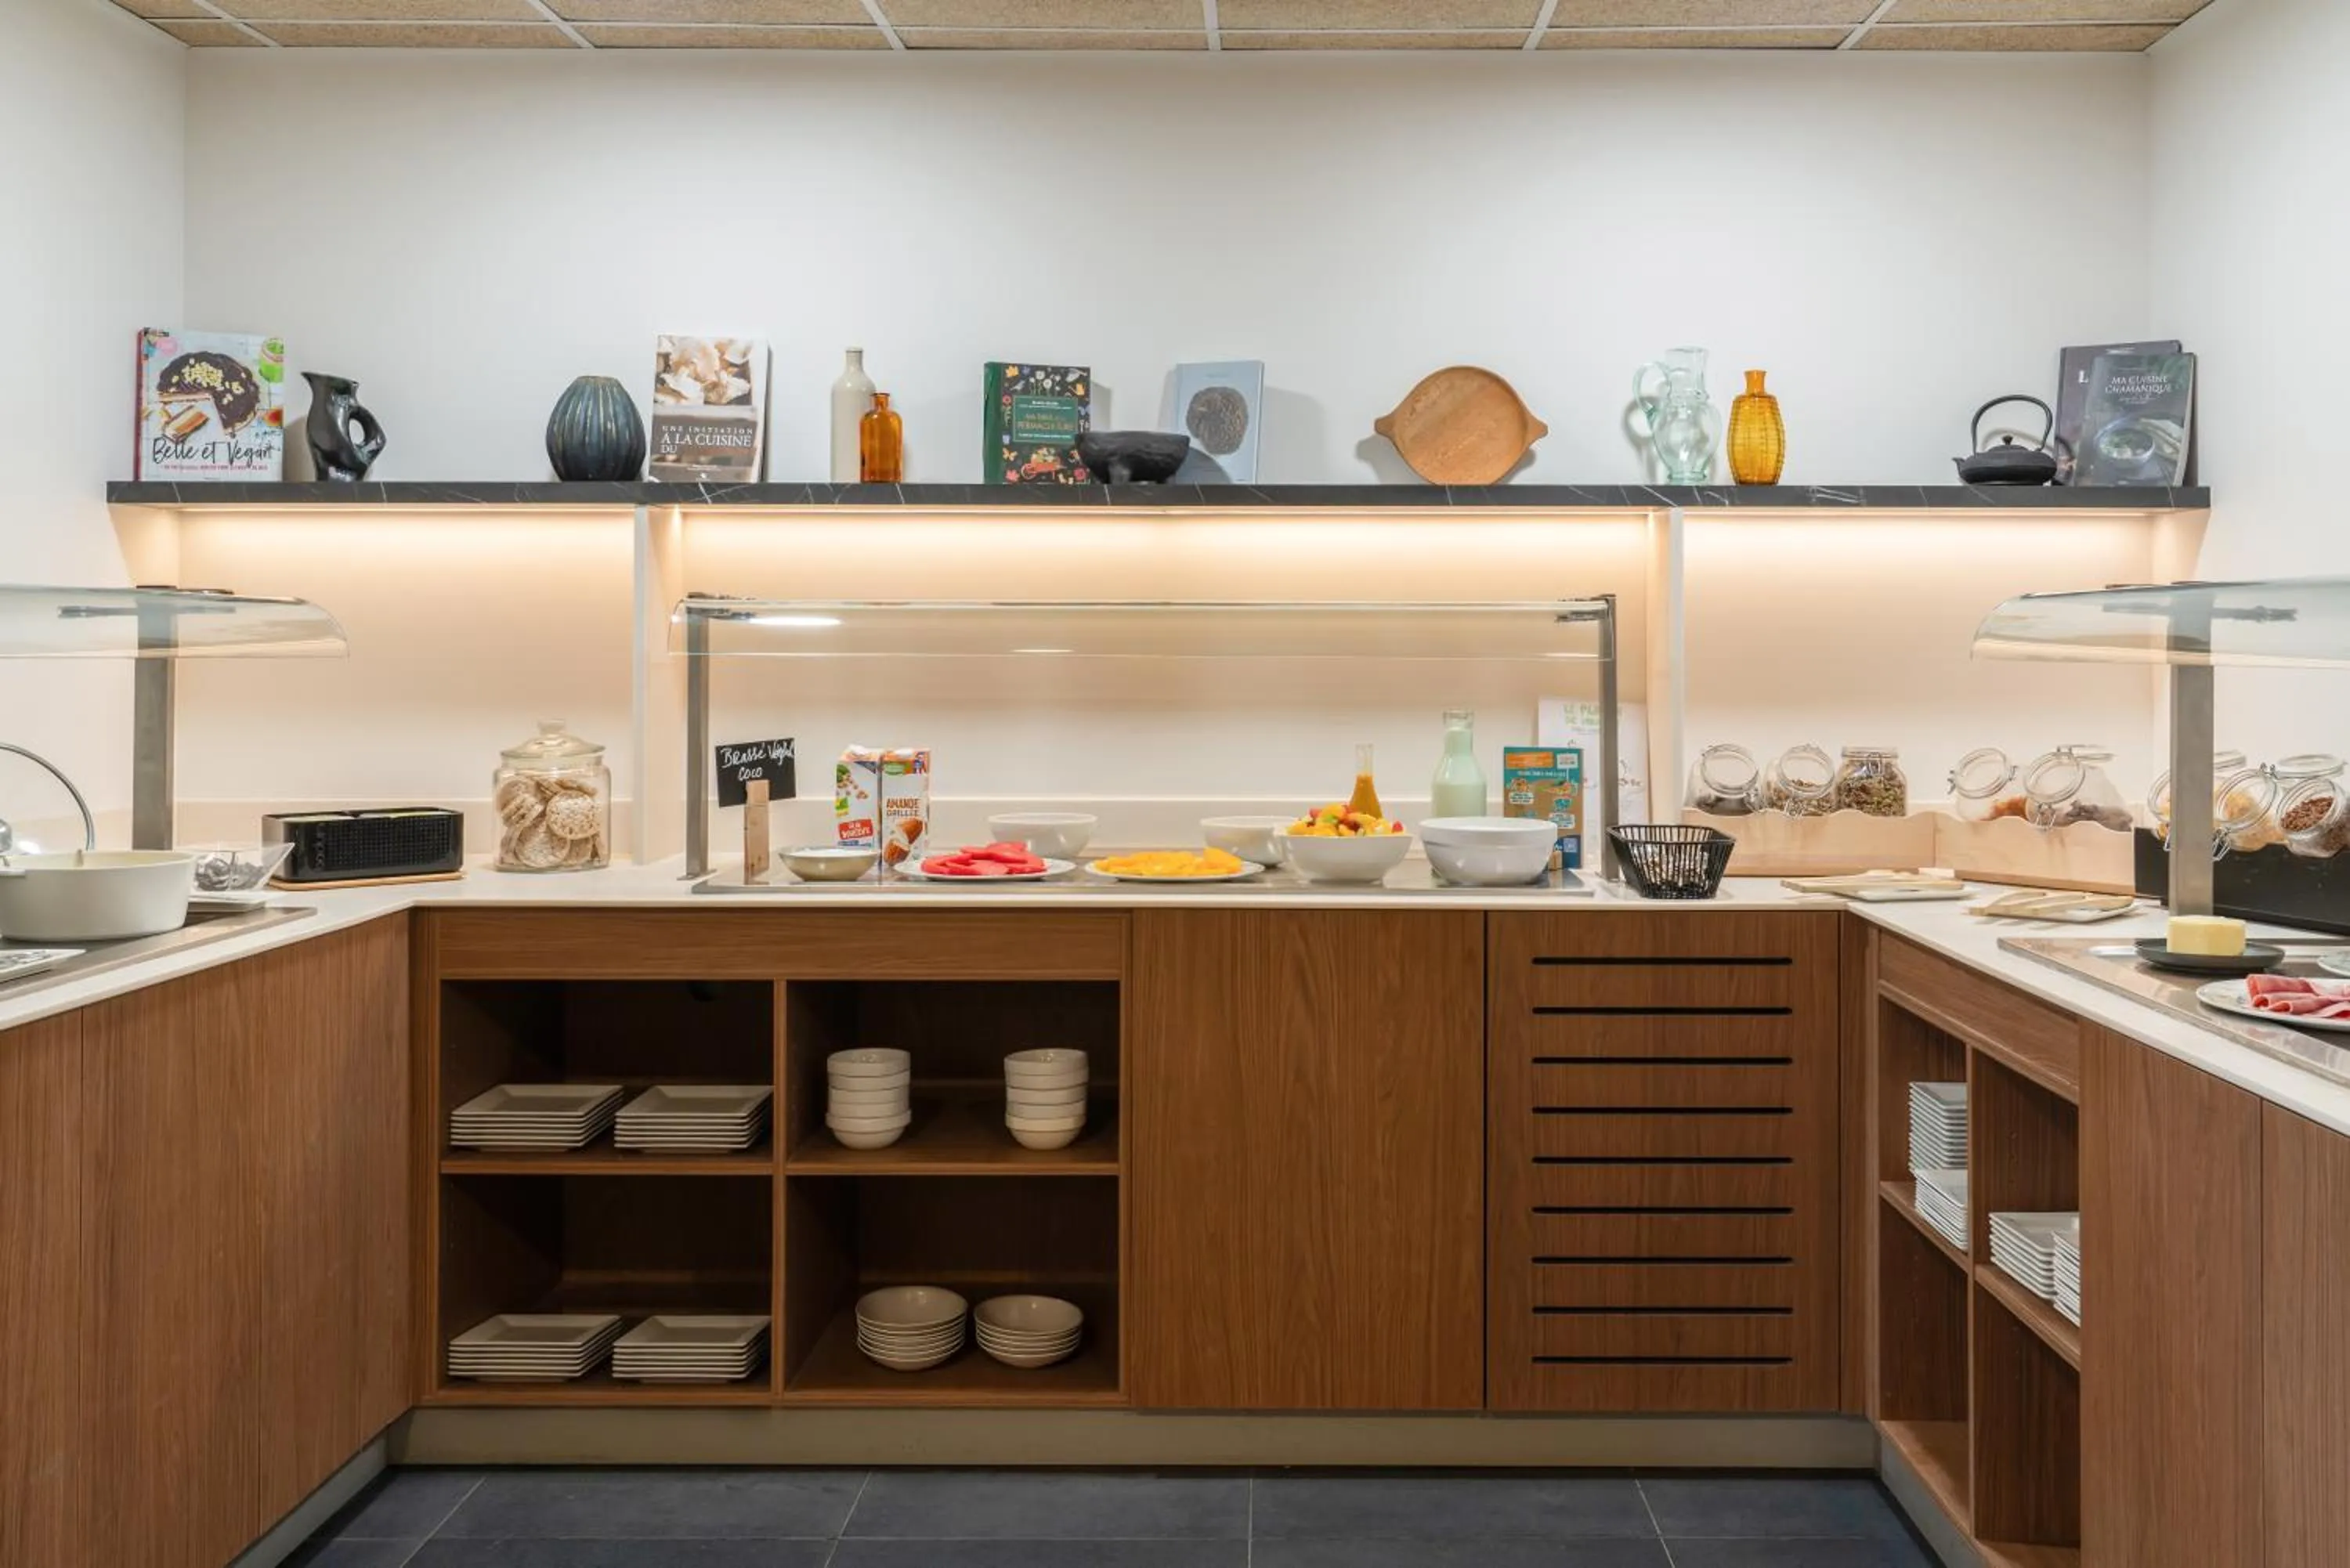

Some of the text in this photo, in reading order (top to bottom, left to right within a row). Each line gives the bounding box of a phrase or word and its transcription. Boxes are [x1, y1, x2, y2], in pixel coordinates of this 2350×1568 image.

[2105, 384, 2171, 394] CHAMANIQUE
[675, 433, 692, 445] LA
[695, 433, 751, 446] CUISINE
[152, 435, 197, 464] Belle
[660, 444, 678, 453] DU
[886, 798, 921, 809] AMANDE
